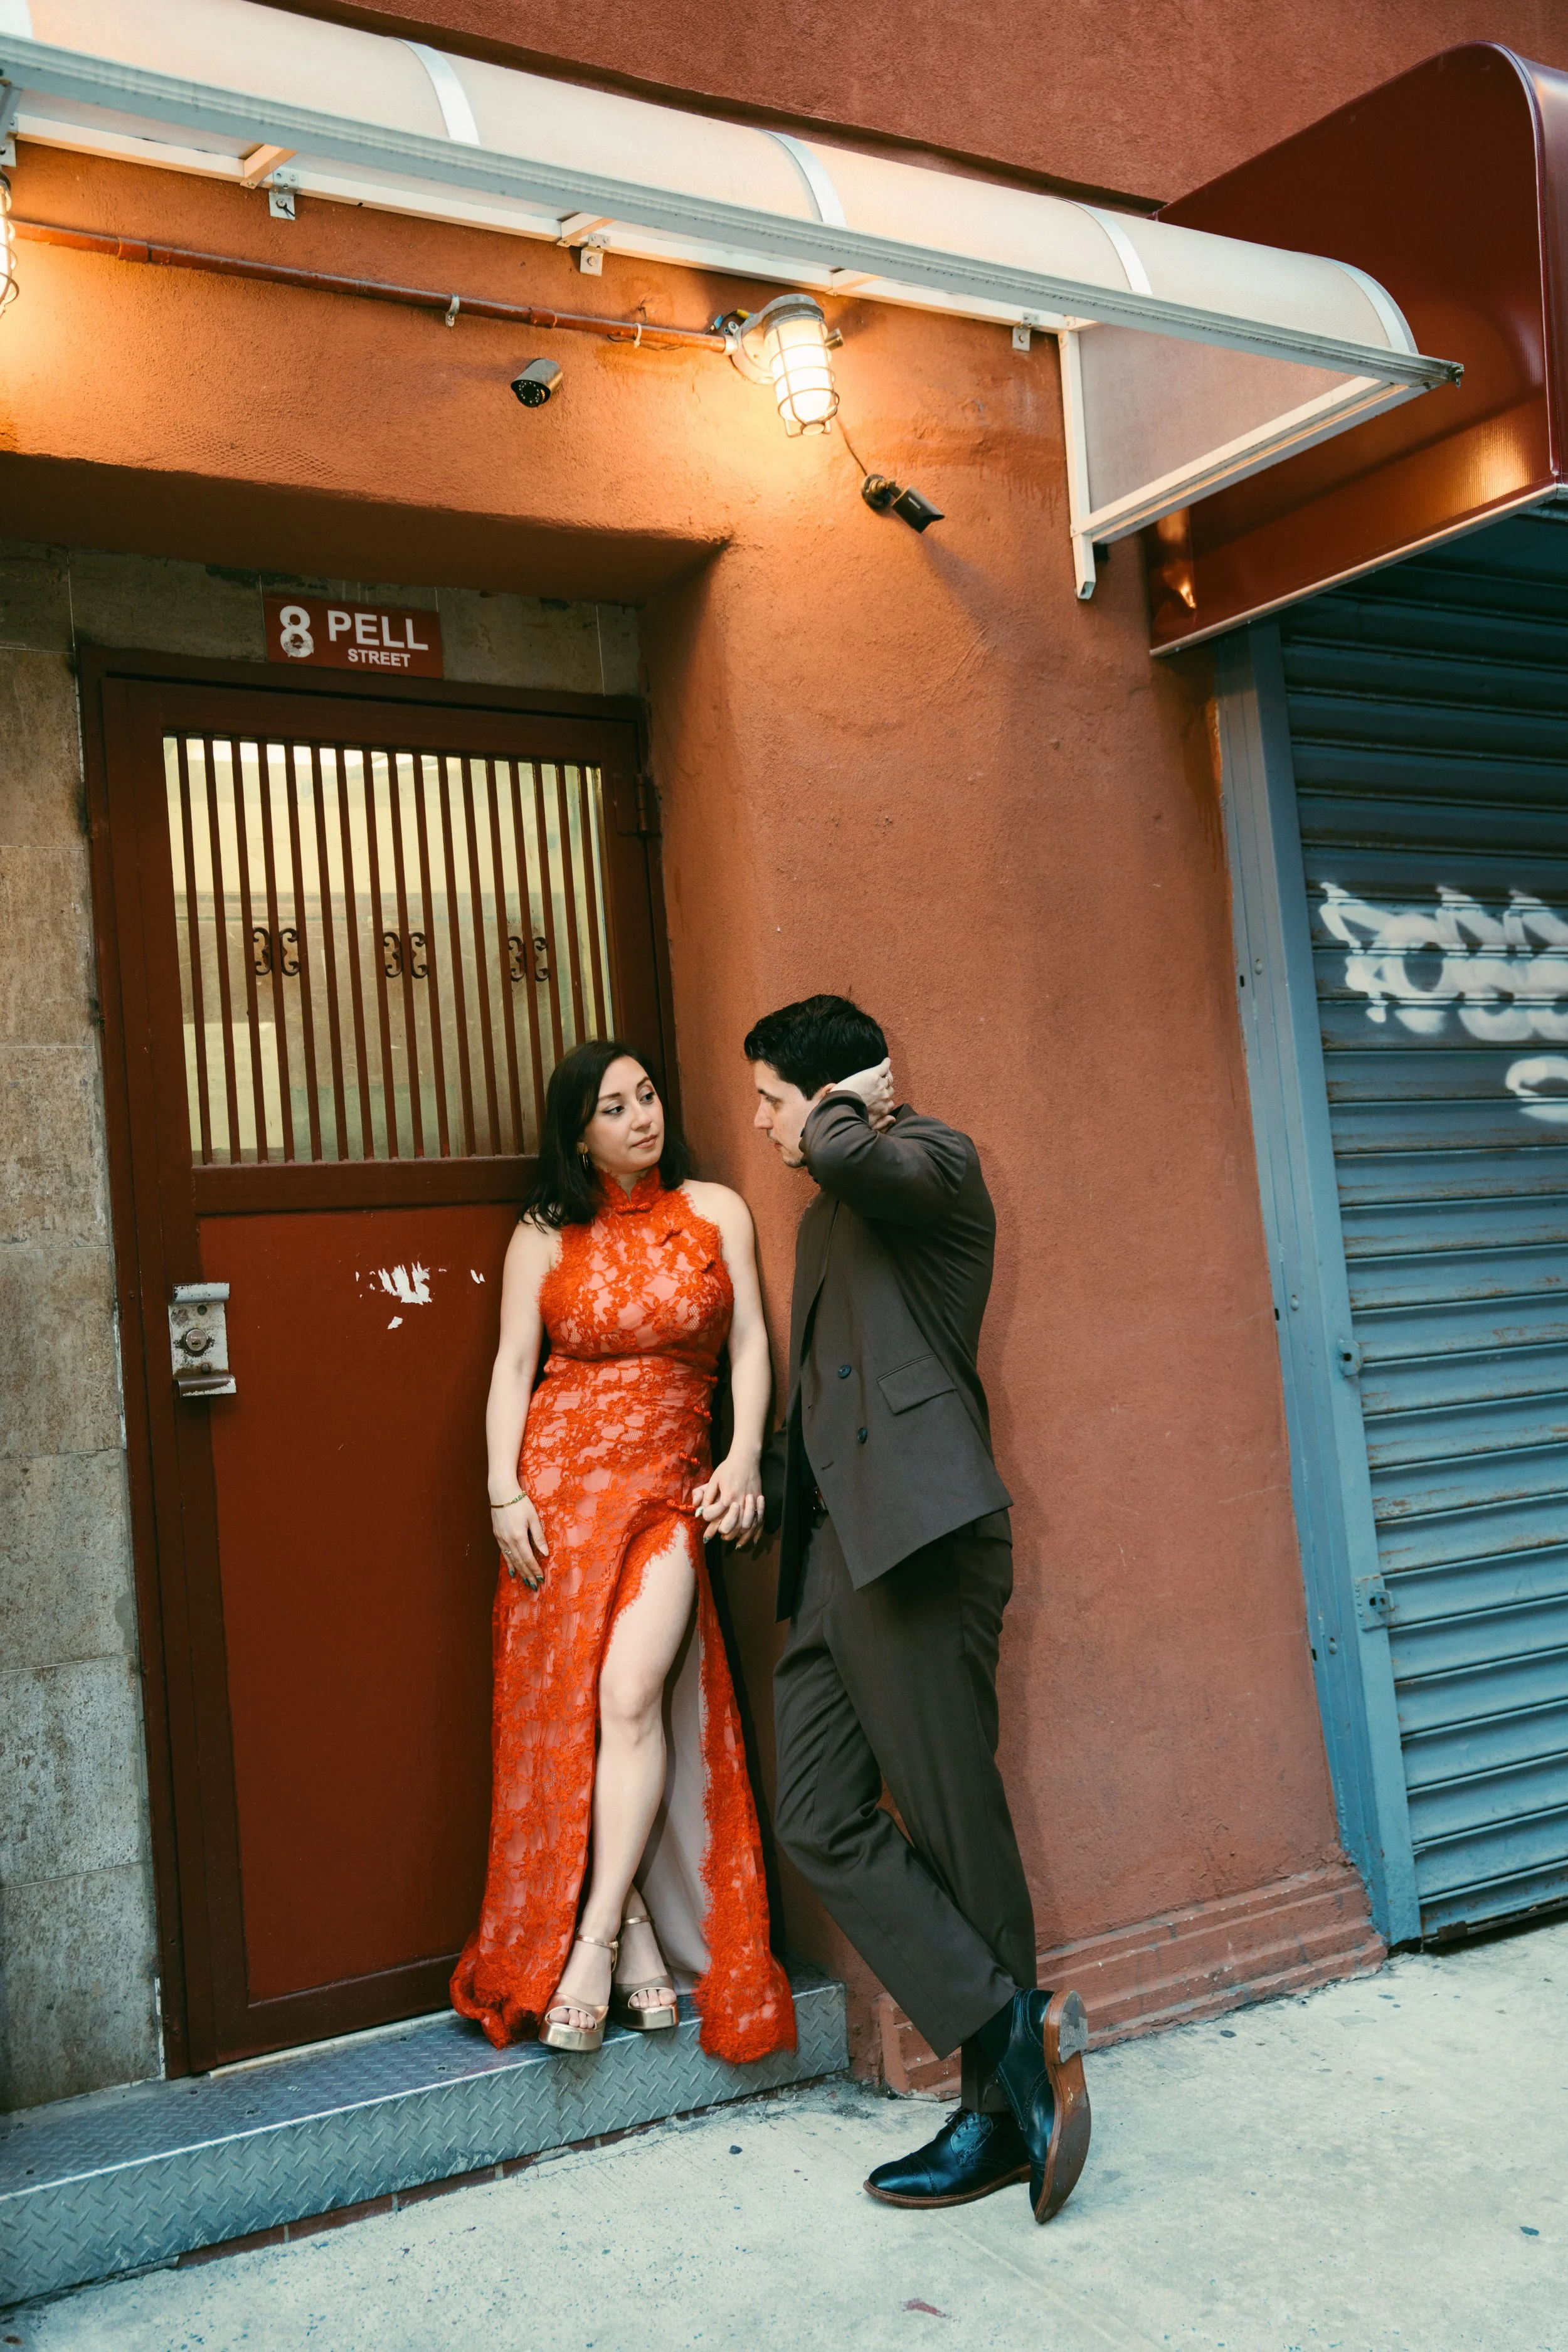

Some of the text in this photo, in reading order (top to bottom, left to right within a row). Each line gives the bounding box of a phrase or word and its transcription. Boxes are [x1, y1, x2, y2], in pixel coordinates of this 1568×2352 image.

[280, 605, 429, 658] 8 PELL
[347, 648, 411, 668] STREET
